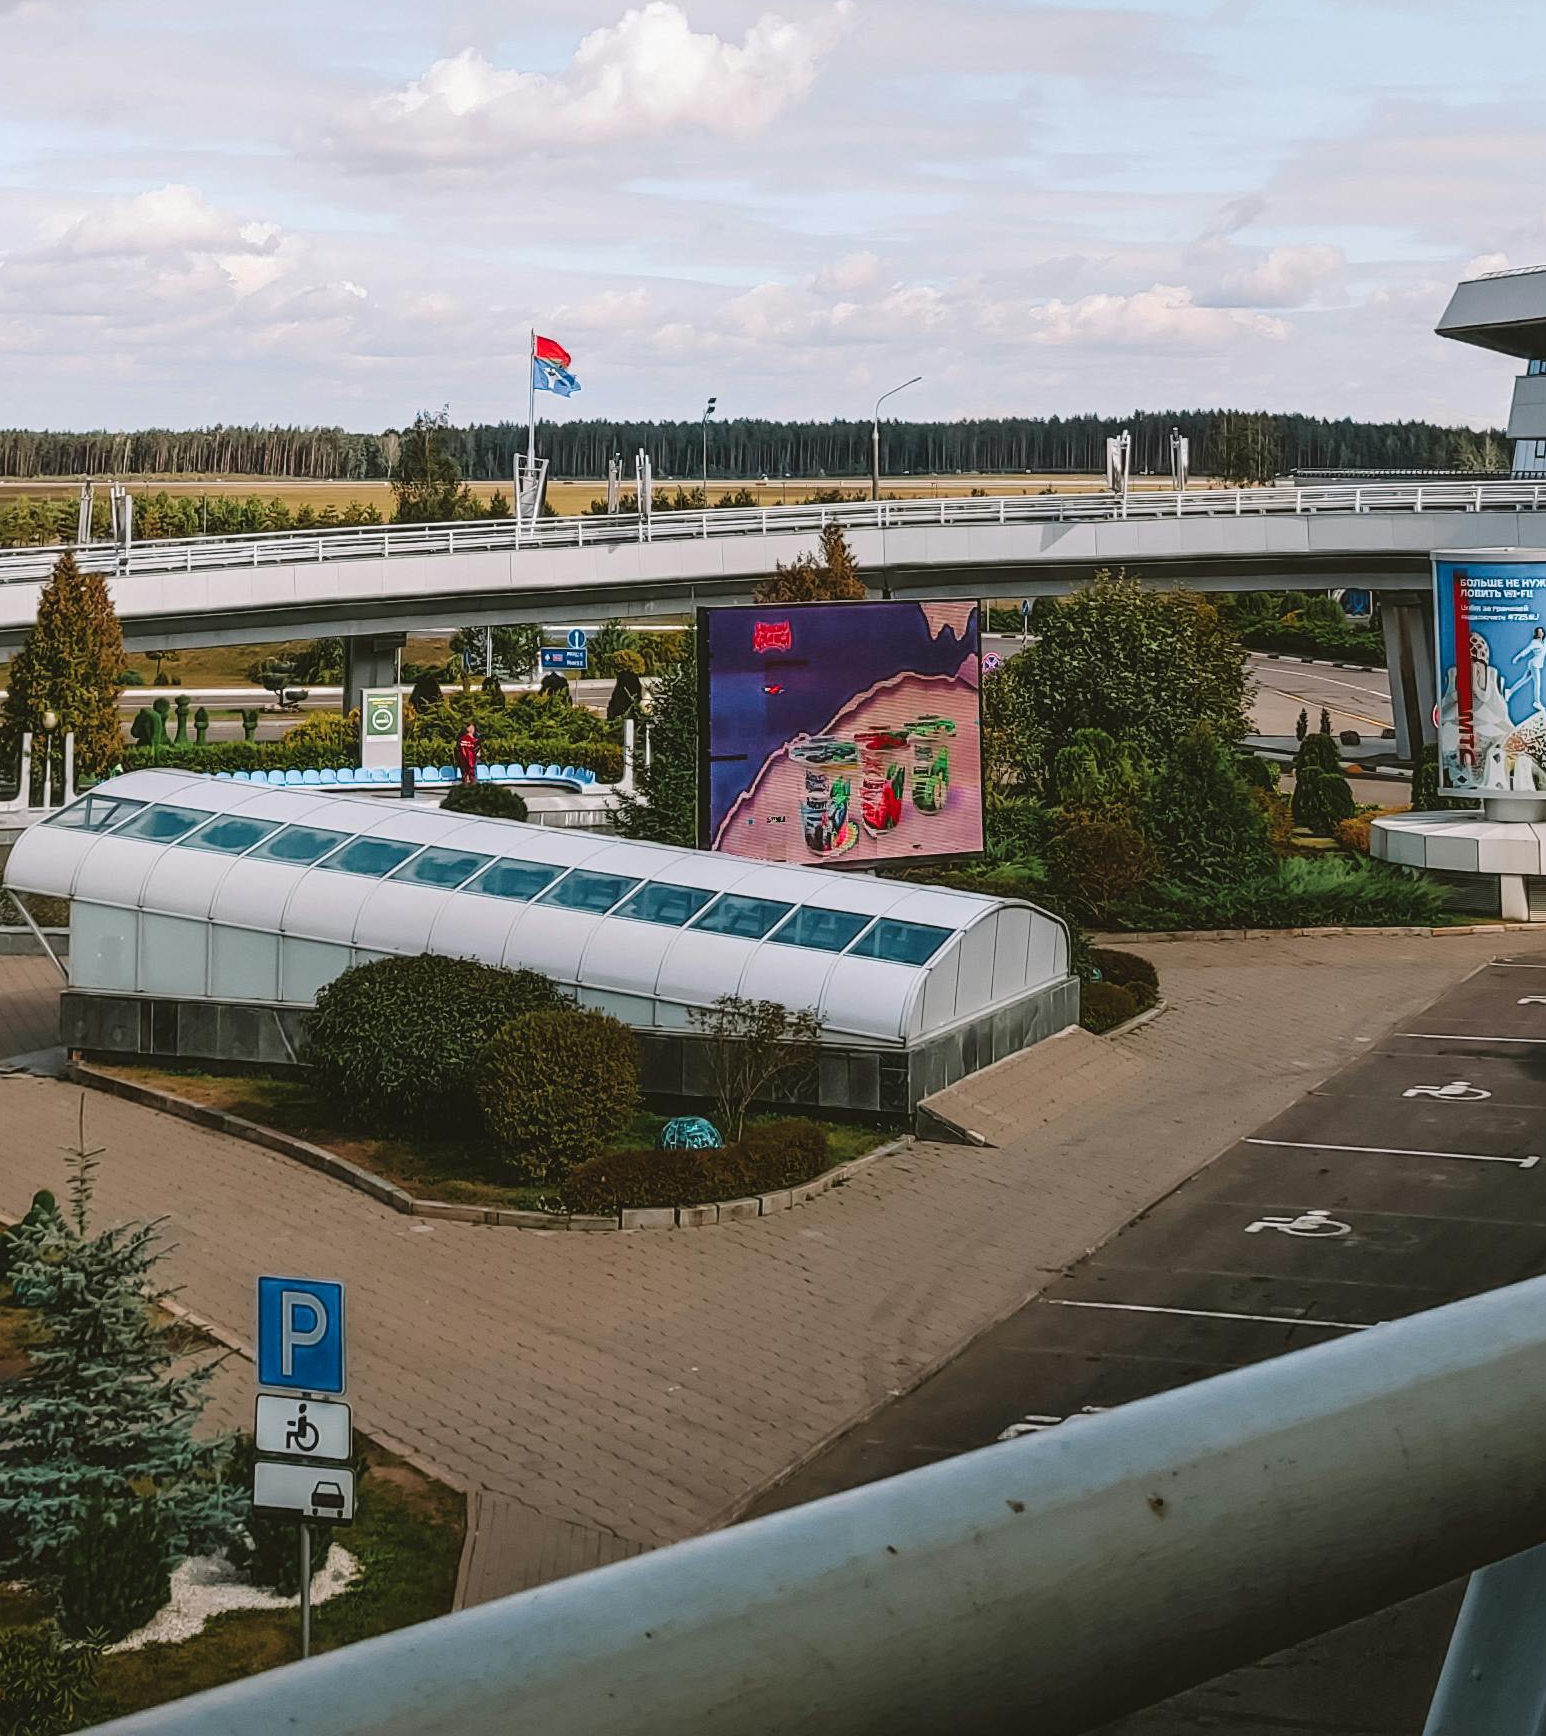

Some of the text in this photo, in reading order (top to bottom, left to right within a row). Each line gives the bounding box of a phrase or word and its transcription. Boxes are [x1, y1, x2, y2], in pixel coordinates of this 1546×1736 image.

[1460, 578, 1503, 587] БОЛЬШЕ
[1505, 578, 1519, 587] НЕ
[1458, 709, 1477, 766] МТС
[282, 1291, 327, 1376] P
